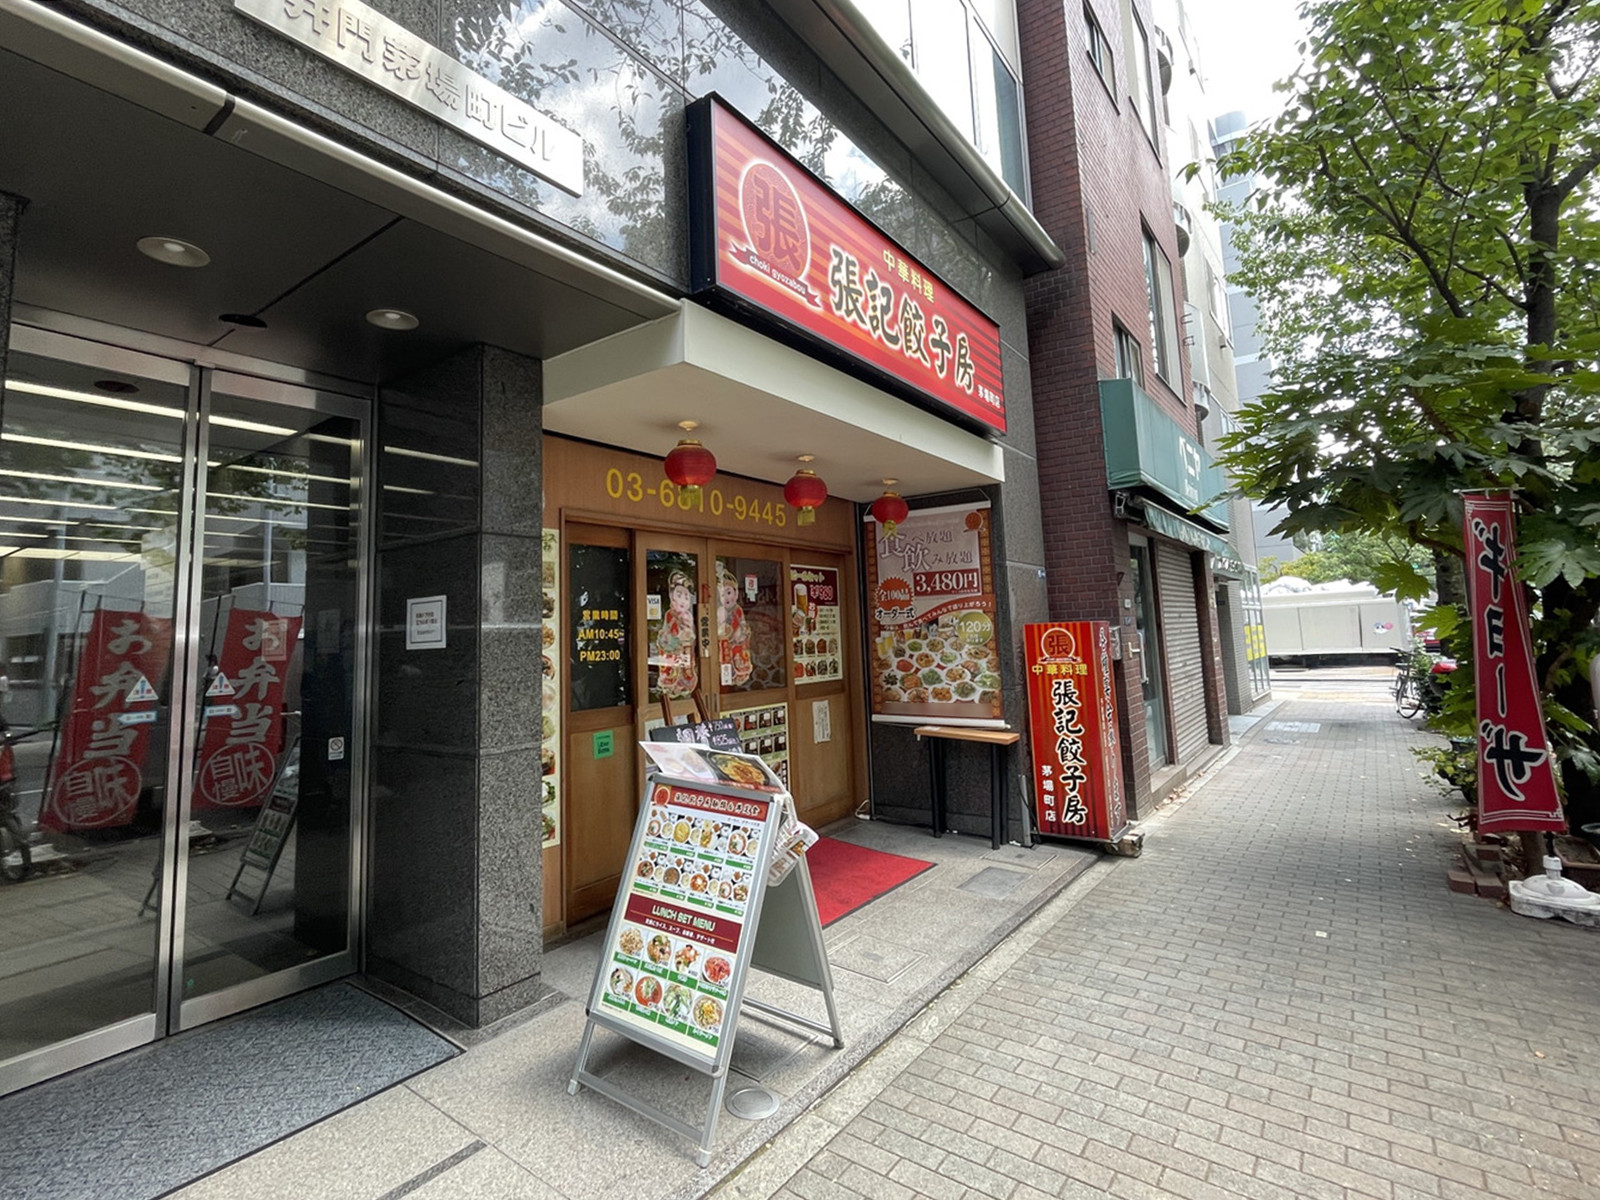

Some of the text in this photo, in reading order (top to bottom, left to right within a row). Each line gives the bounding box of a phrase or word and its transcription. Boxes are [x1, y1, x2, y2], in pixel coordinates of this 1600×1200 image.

[753, 176, 801, 270] 張
[883, 250, 934, 303] 中華料理
[829, 247, 976, 394] 張記餃子房
[916, 571, 978, 593] 3,480円
[876, 606, 916, 620] オーダー式
[960, 620, 991, 633] 120分
[580, 650, 620, 662] PM23:00
[1047, 633, 1070, 656] 張
[84, 617, 152, 758] お弁当
[226, 617, 281, 746] お弁当
[1031, 663, 1089, 677] 中華料理
[1053, 680, 1088, 824] 張記餃子房
[1041, 765, 1056, 822] 茅場町店
[652, 905, 716, 932] LUNCH SET MENU
